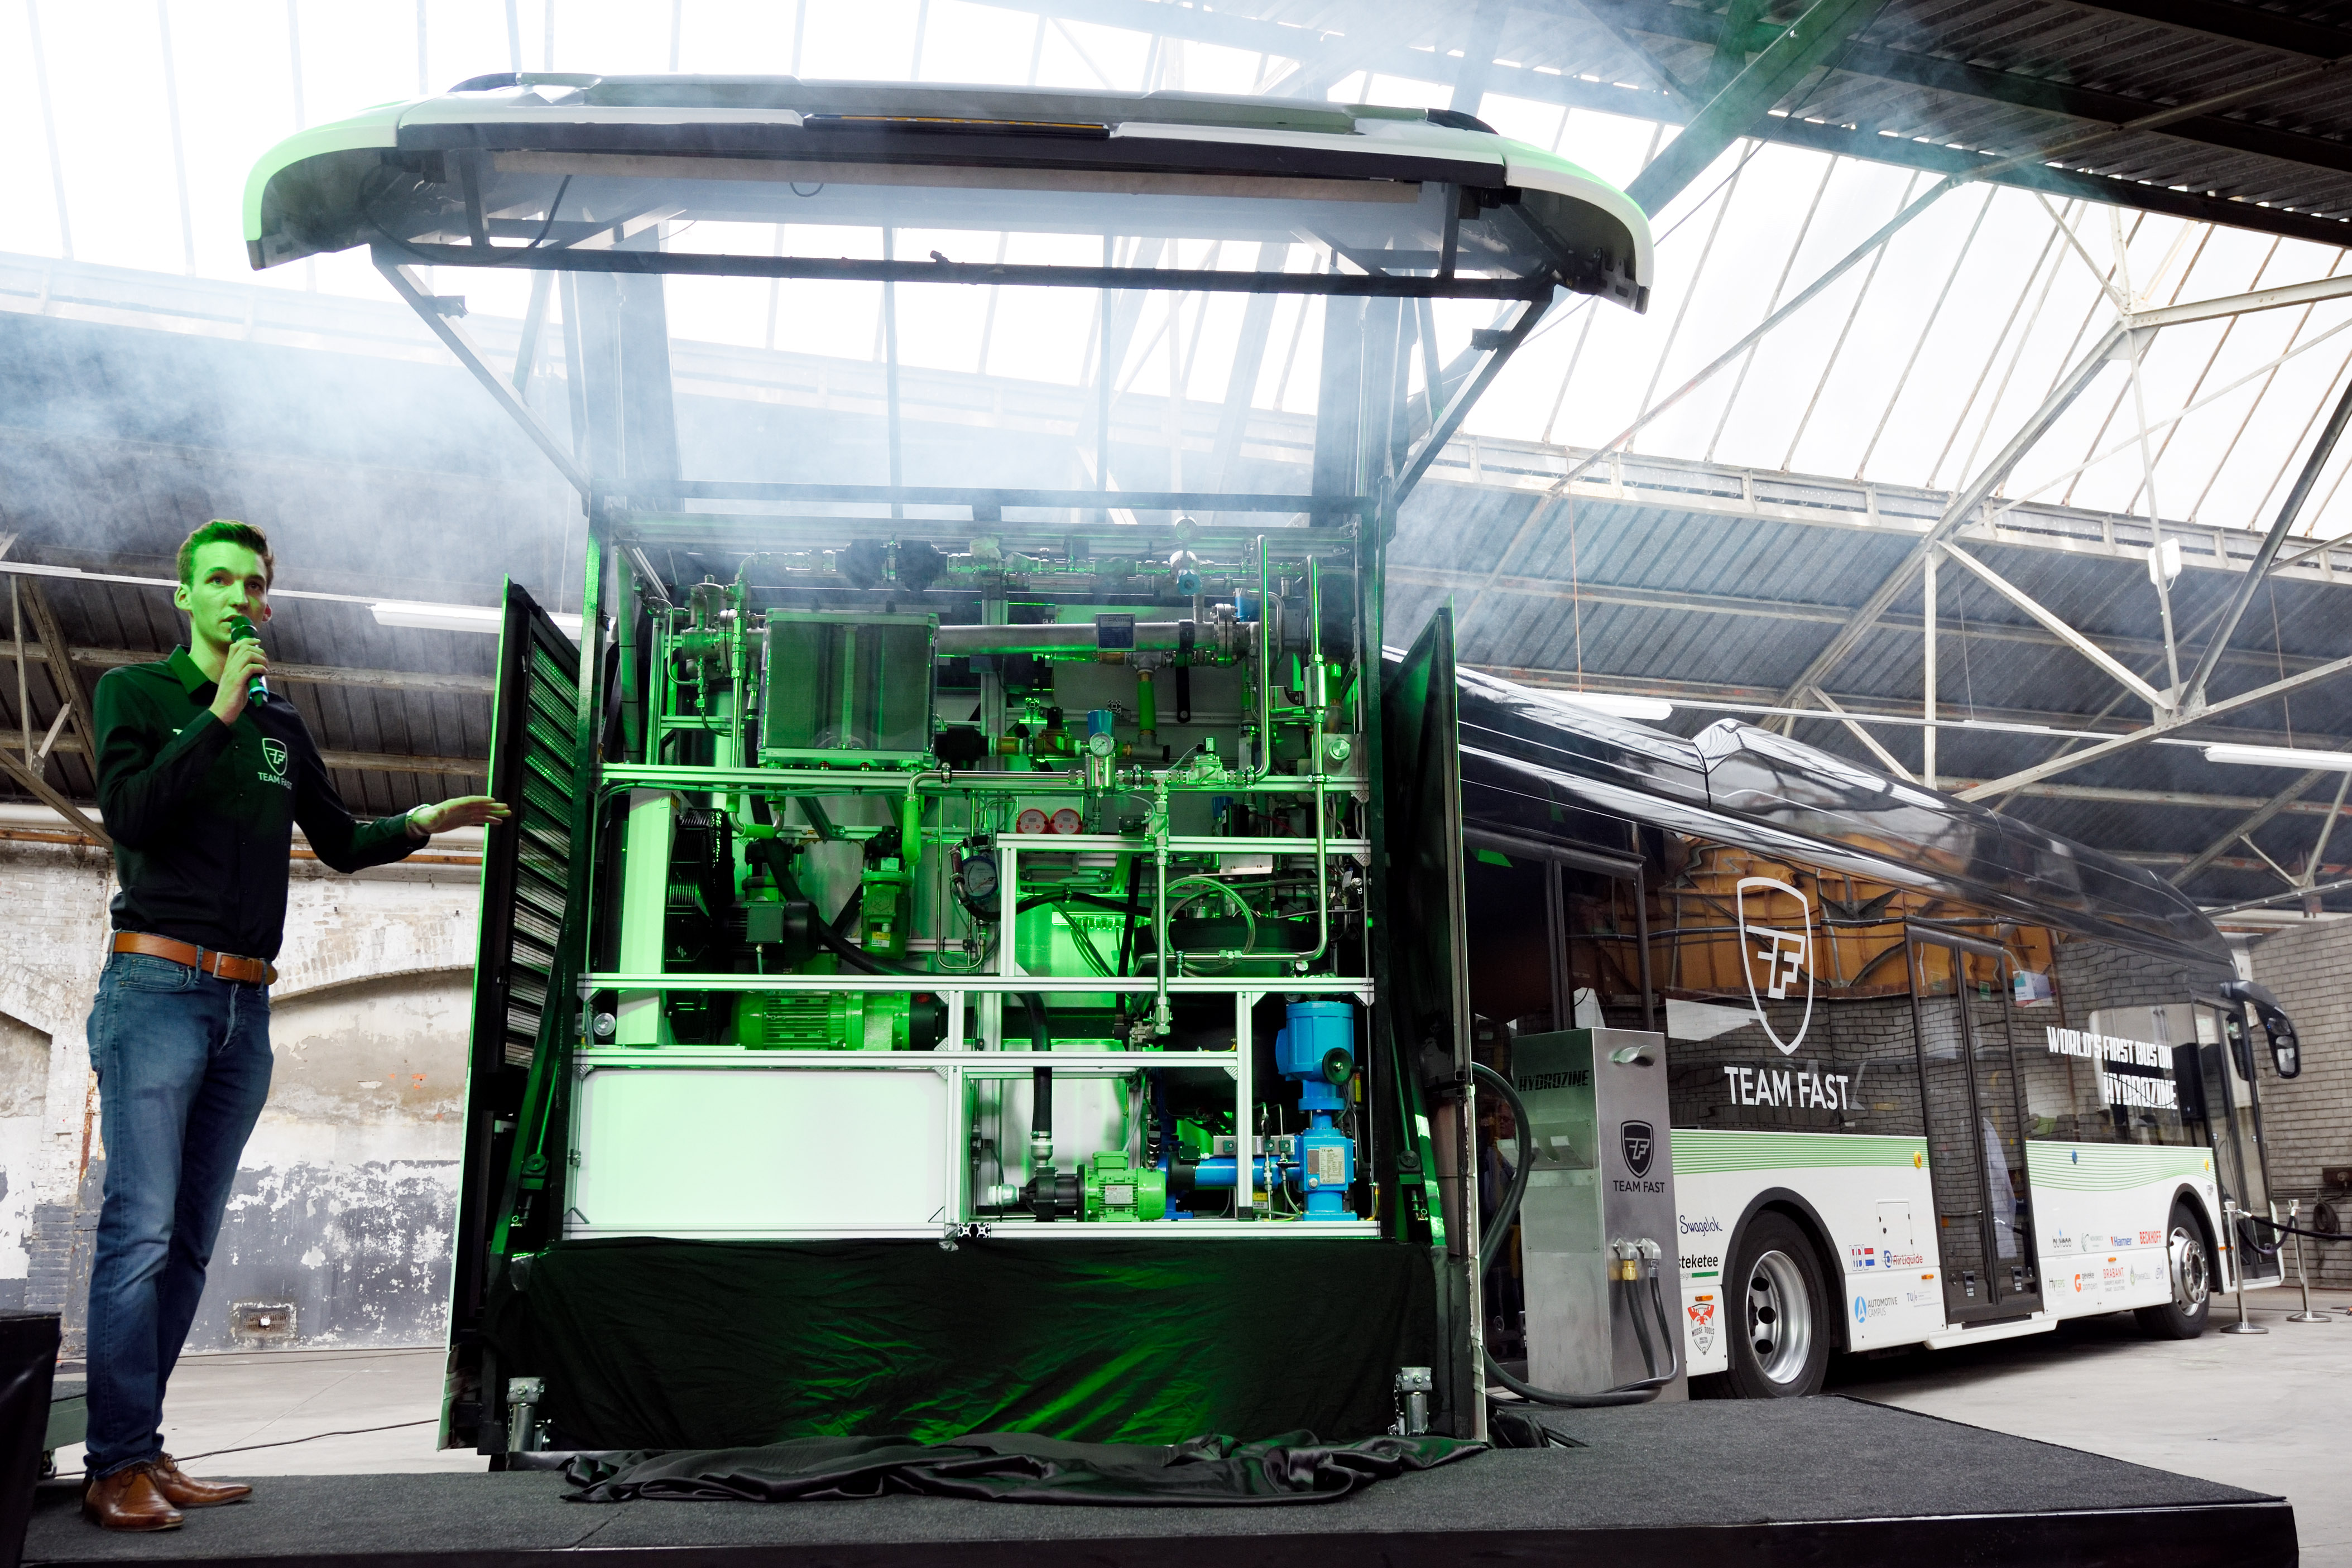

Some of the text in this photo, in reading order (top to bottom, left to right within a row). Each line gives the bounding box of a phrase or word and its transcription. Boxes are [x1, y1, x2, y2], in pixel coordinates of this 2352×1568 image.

[257, 772, 292, 790] TEAM FAST
[2047, 1026, 2173, 1069] WORLD'S FIRST BUS ON
[1519, 1070, 1589, 1091] HYDROZINE
[1724, 1066, 1849, 1110] TEAM FAST
[2104, 1072, 2178, 1110] HYDROZINE
[1613, 1180, 1665, 1193] TEAM FAST
[1679, 1215, 1722, 1236] Swagelok
[2114, 1236, 2132, 1247] Hamer
[2139, 1230, 2161, 1244] BECKHOFF
[2103, 1267, 2124, 1279] BRABANT
[1868, 1297, 1898, 1308] AUTOMOTIVE
[1868, 1307, 1887, 1317] CAMPUS
[1692, 1326, 1715, 1337] MOOSE TOOLS
